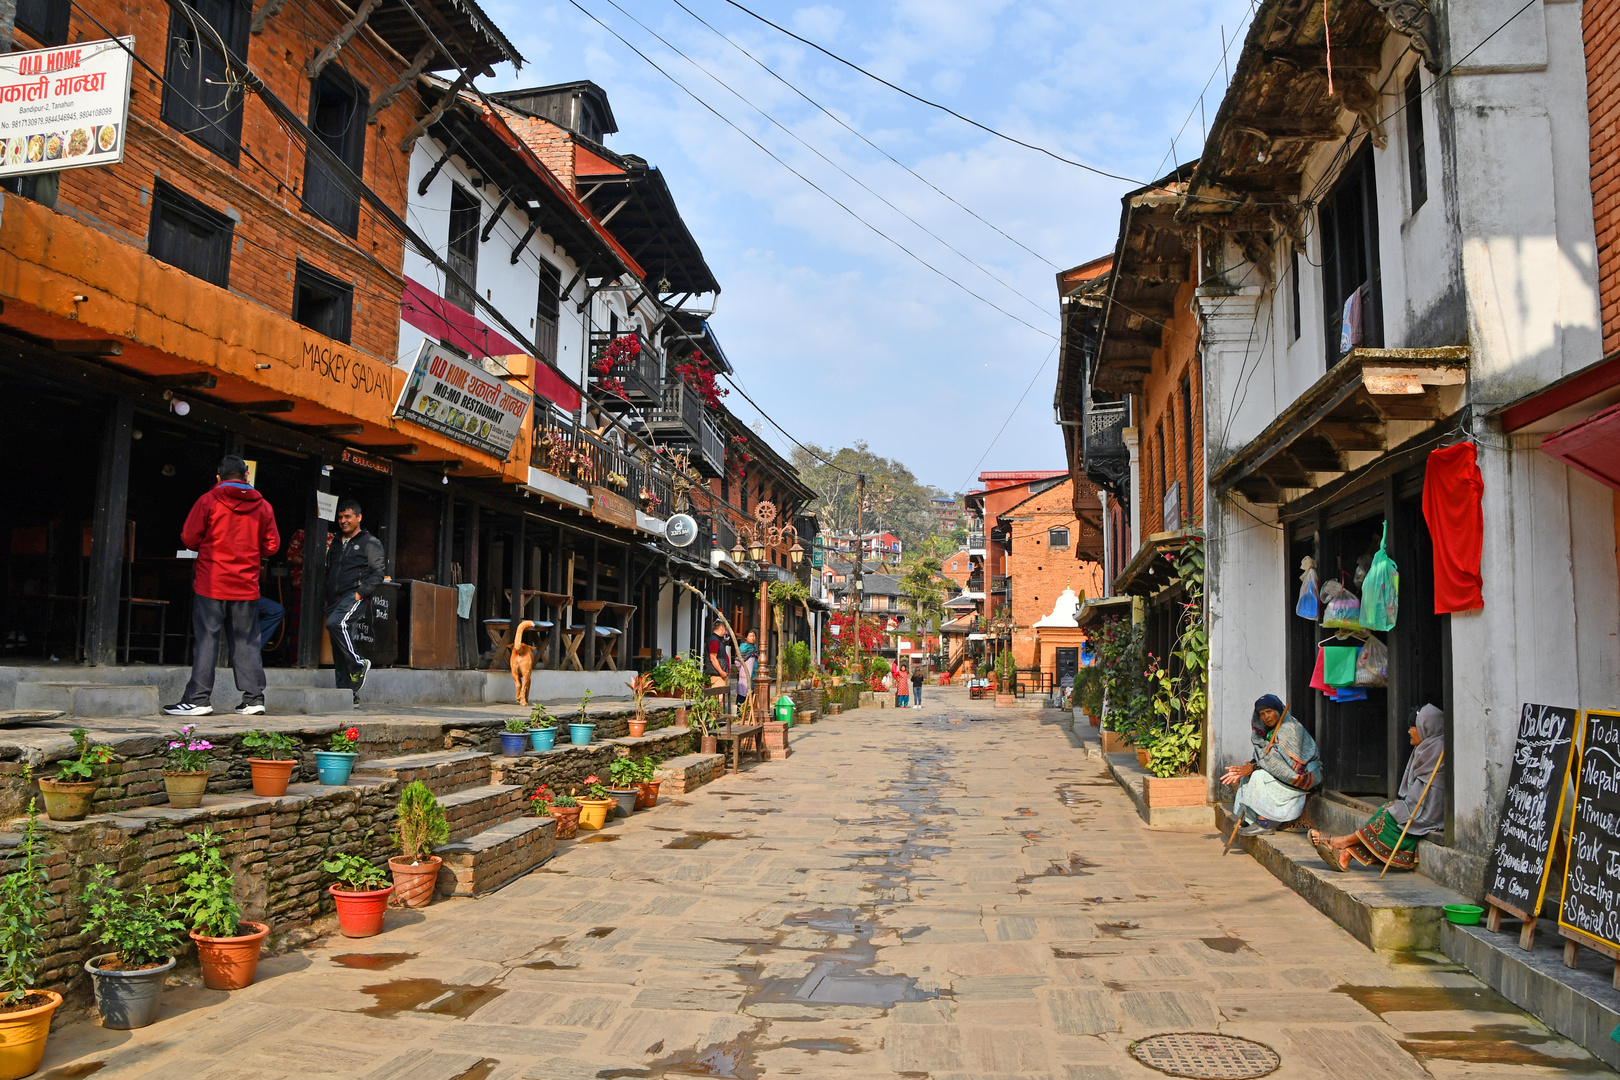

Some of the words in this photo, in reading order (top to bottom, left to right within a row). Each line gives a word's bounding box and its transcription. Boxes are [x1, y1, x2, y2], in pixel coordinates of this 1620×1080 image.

[19, 55, 42, 75] OLD
[47, 49, 82, 73] HOME
[51, 100, 75, 110] Tanahun
[54, 72, 107, 96] भान्छा
[302, 341, 351, 384] MASKEY
[351, 362, 392, 402] SADAN
[429, 355, 449, 379] OLD
[445, 363, 471, 391] HOME
[467, 375, 502, 406] थकाली
[433, 381, 462, 405] MO:MO
[460, 393, 505, 425] RESTAURANT
[1584, 759, 1620, 799] Nepali
[1571, 864, 1614, 912] Sizzling
